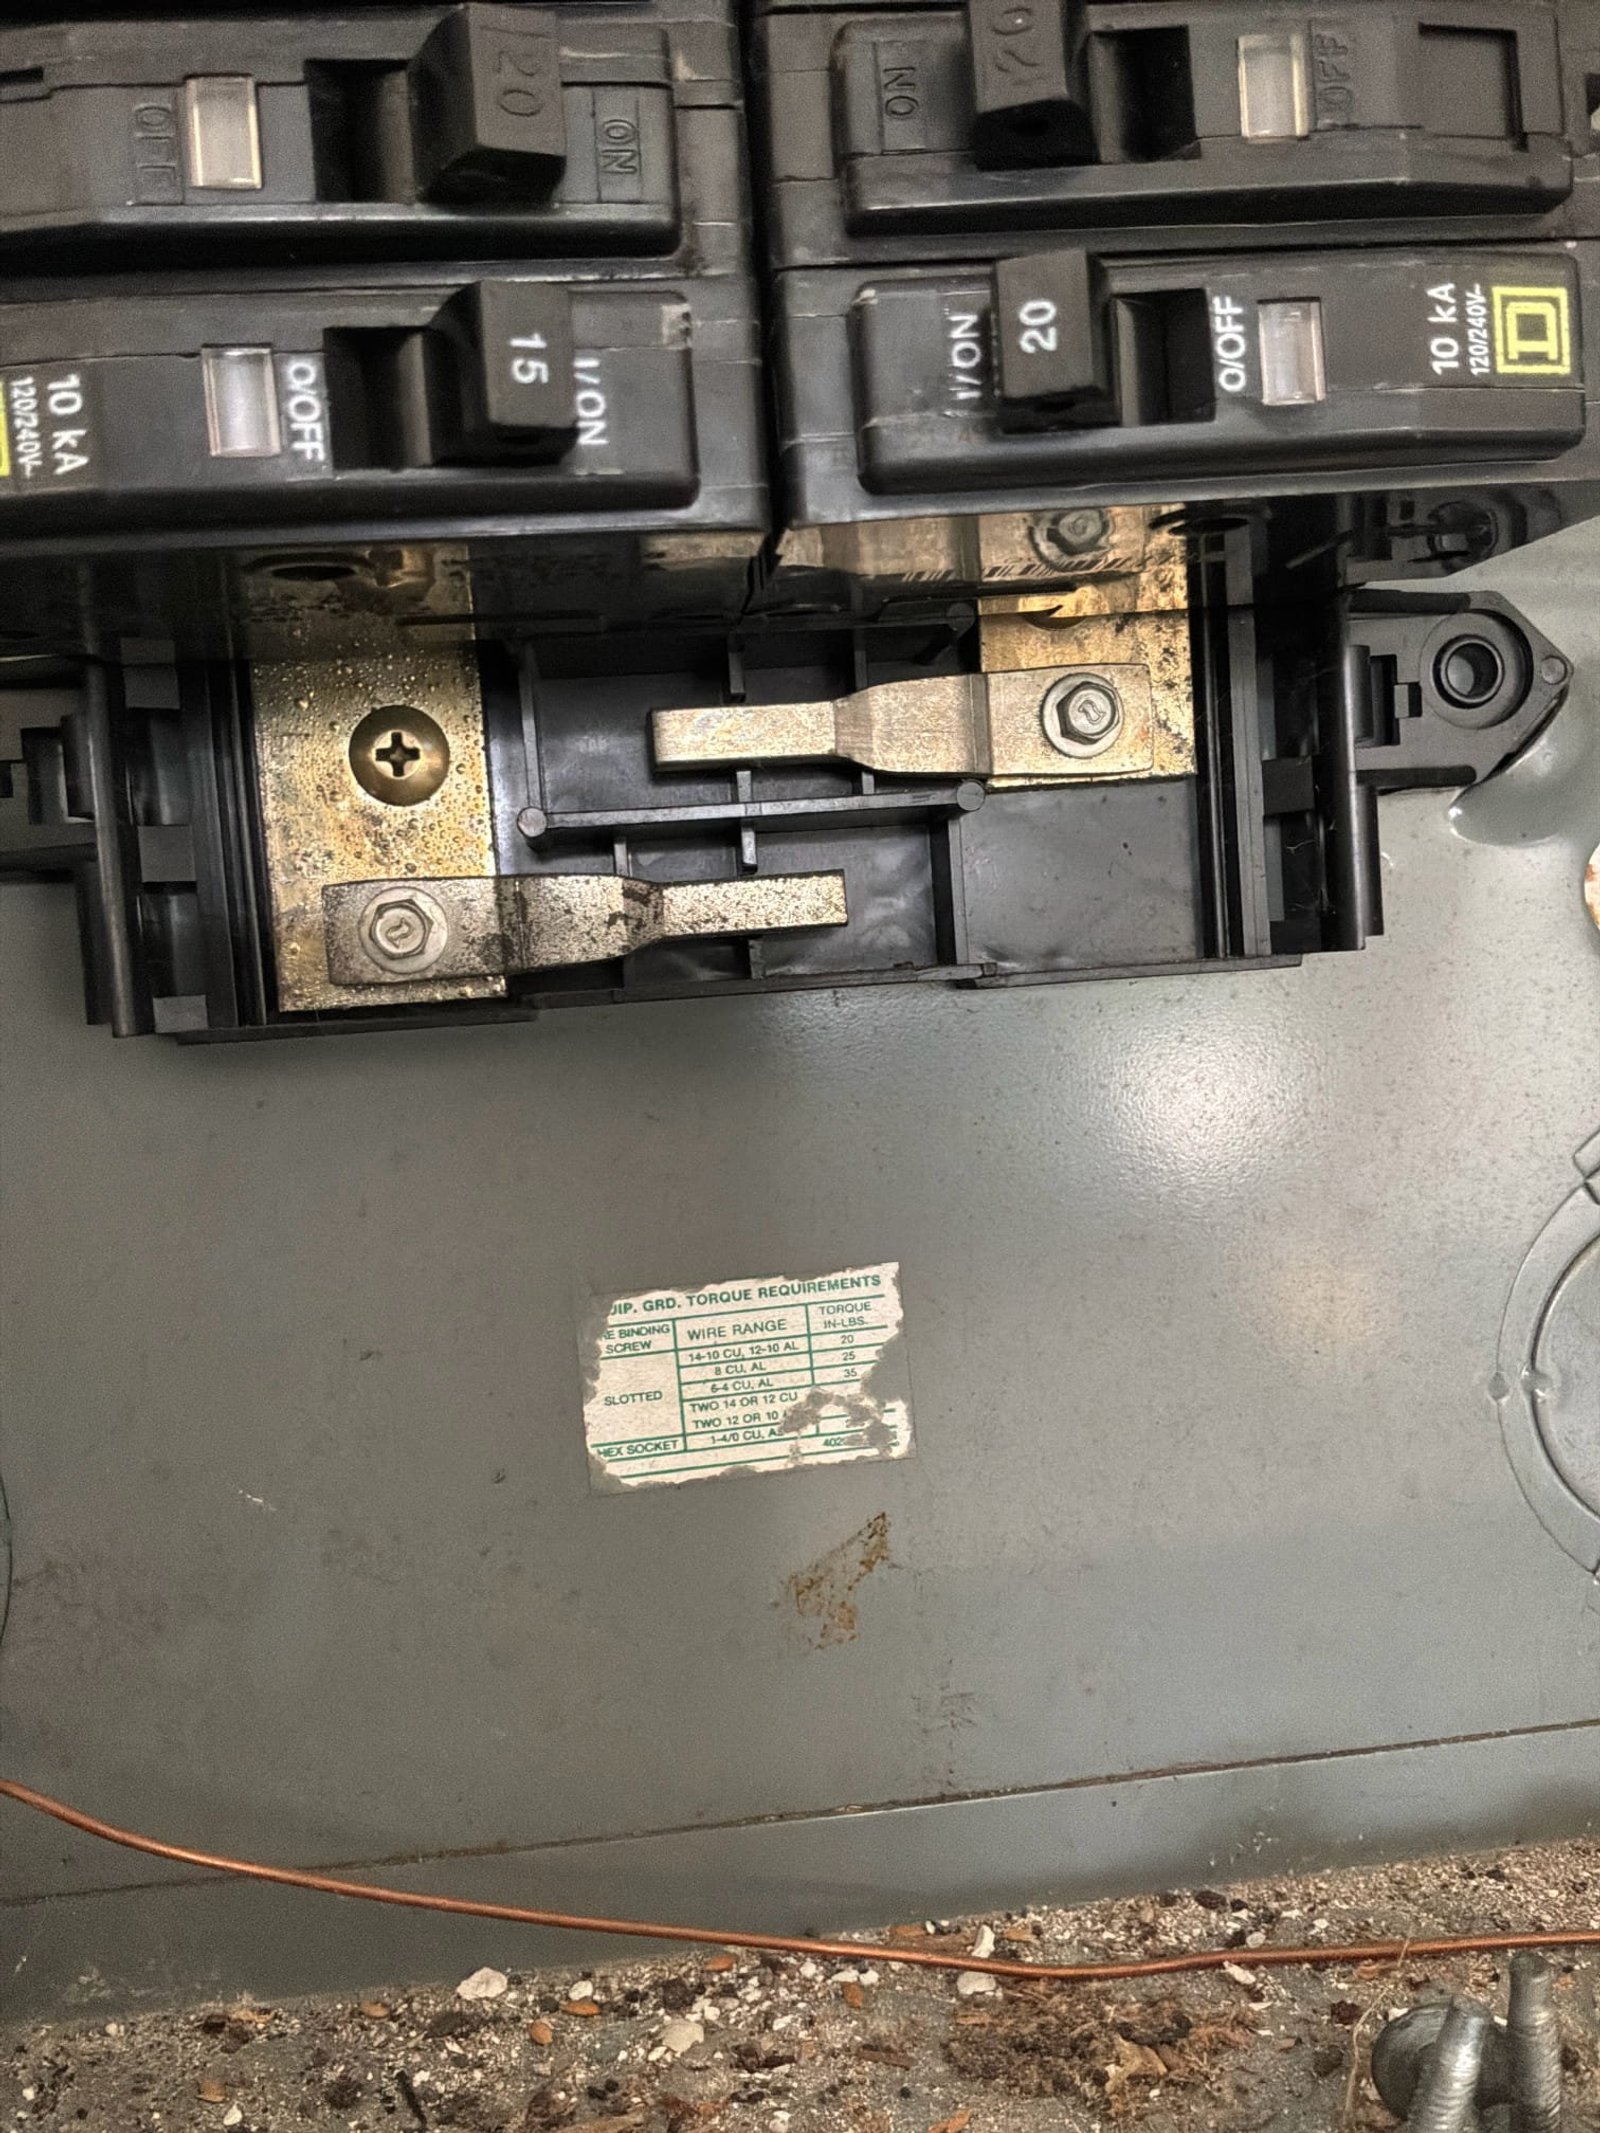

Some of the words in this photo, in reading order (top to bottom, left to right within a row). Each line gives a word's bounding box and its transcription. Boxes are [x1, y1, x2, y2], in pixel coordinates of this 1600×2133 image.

[883, 66, 919, 119] ON
[602, 118, 638, 175] ON
[1427, 282, 1457, 323] kA
[1019, 299, 1057, 354] 20
[510, 333, 549, 384] 15
[1430, 338, 1460, 376] 10
[48, 373, 82, 416] 10
[52, 429, 89, 475] kA
[643, 1297, 682, 1312] GRD.
[686, 1289, 752, 1307] TORQUE
[758, 1274, 881, 1299] REQUIREMENTS
[819, 1301, 872, 1315] TORQUE
[618, 1323, 670, 1339] BINDING
[687, 1326, 726, 1341] WIRE
[732, 1319, 787, 1335] RANGE
[840, 1334, 854, 1344] 20
[605, 1340, 652, 1354] SCREW
[688, 1350, 720, 1362] 14-10
[749, 1343, 779, 1355] 12-10
[784, 1341, 799, 1351] AL
[842, 1351, 856, 1361] 25
[715, 1366, 721, 1376] 8
[751, 1362, 766, 1372] AL
[844, 1368, 857, 1378] 35
[710, 1383, 729, 1394] 6-4
[758, 1378, 774, 1388] AL
[604, 1390, 663, 1407] SLOTTED
[690, 1401, 720, 1413] TWO
[723, 1399, 737, 1409] 14
[740, 1396, 759, 1407] OR
[763, 1394, 776, 1405] 12
[779, 1392, 799, 1402] CU
[692, 1417, 722, 1430] TWO
[726, 1415, 739, 1425] 12
[743, 1412, 762, 1424] OR
[767, 1410, 779, 1420] 10
[627, 1440, 679, 1455] SOCKET
[711, 1432, 740, 1444] 1-4/0
